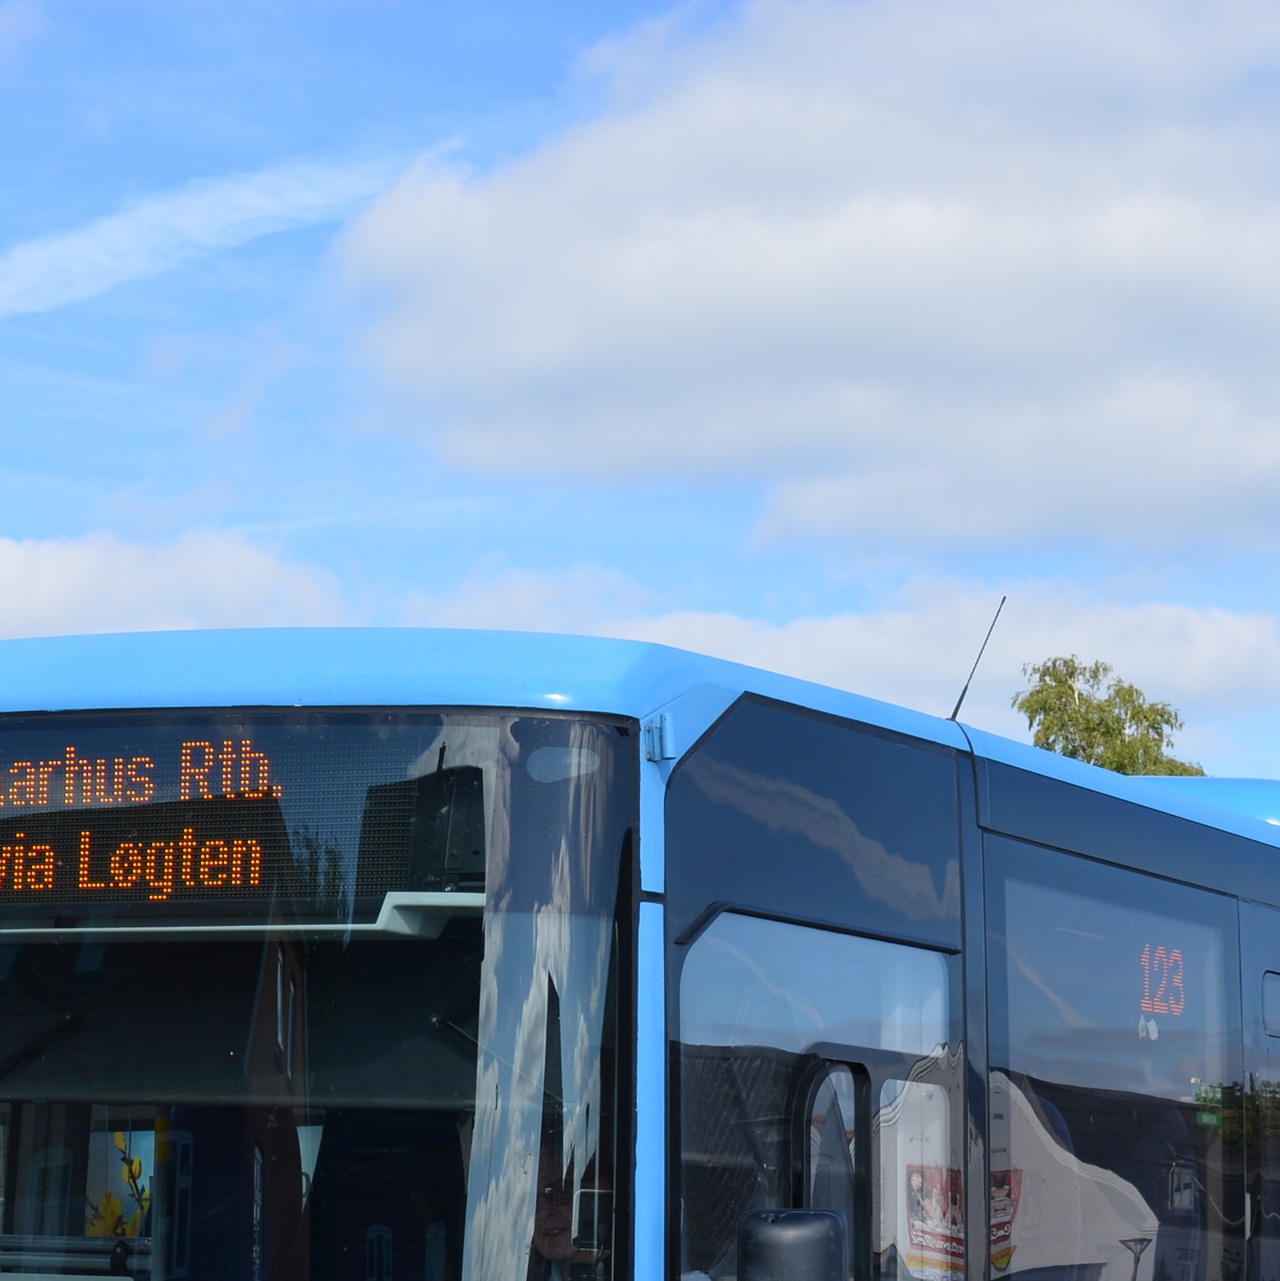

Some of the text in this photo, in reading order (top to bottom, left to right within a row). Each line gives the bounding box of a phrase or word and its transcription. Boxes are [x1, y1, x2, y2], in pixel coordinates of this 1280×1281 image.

[180, 739, 283, 801] Rtb.
[78, 828, 262, 900] Løgten
[1140, 943, 1185, 1016] 123
